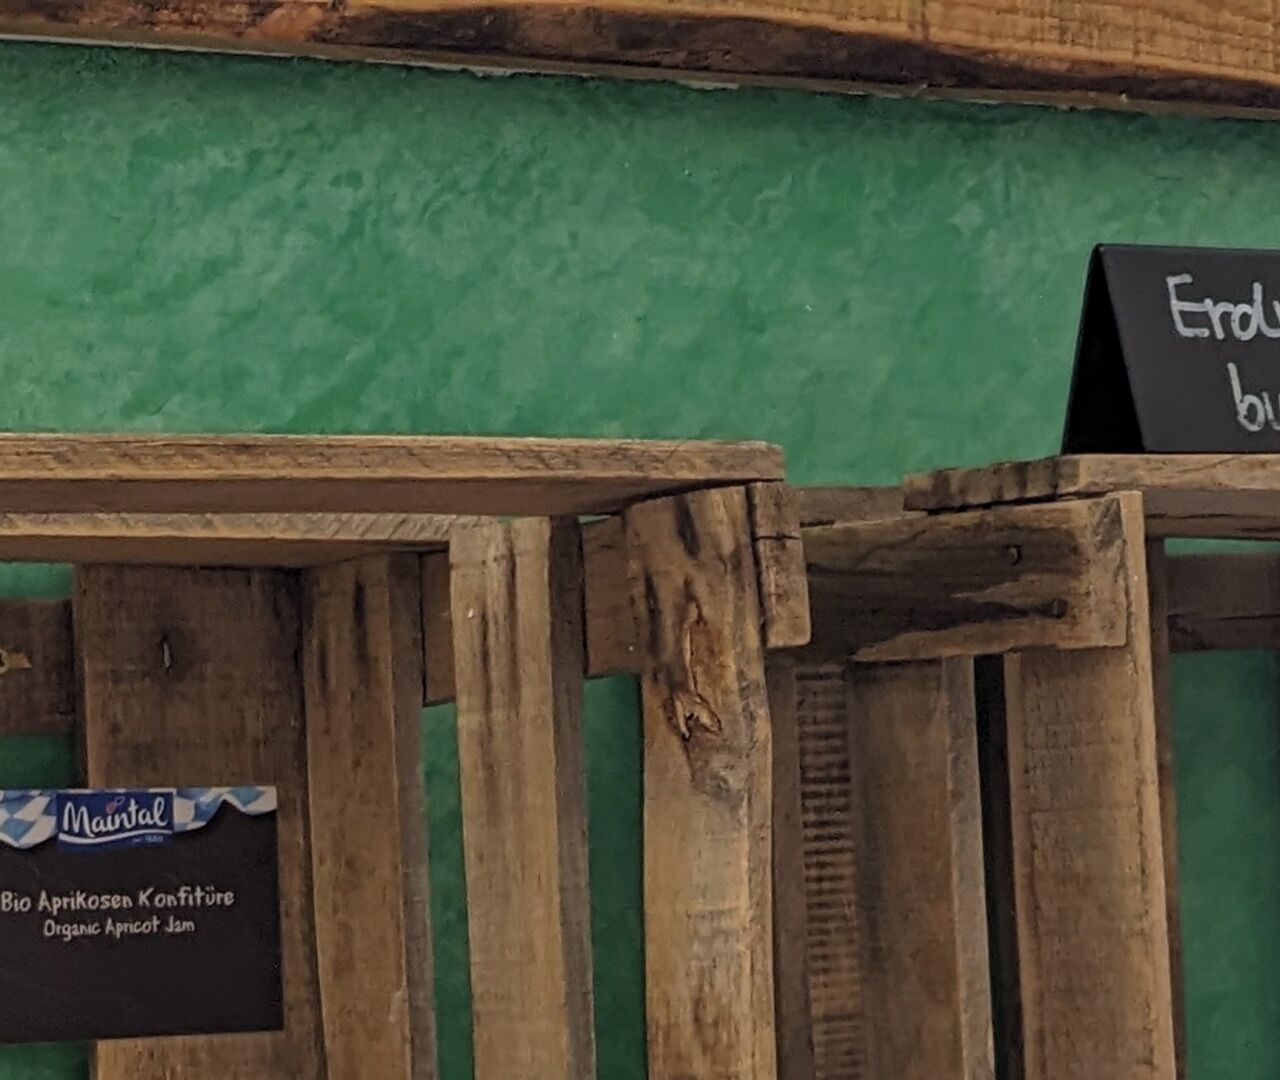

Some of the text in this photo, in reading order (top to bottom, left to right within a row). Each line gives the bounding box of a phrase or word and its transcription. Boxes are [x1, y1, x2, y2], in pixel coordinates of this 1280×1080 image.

[63, 796, 168, 838] Maintal
[0, 886, 235, 916] Bio Aprikosen Konfitüre
[43, 915, 196, 941] Organic Apricot Jam
